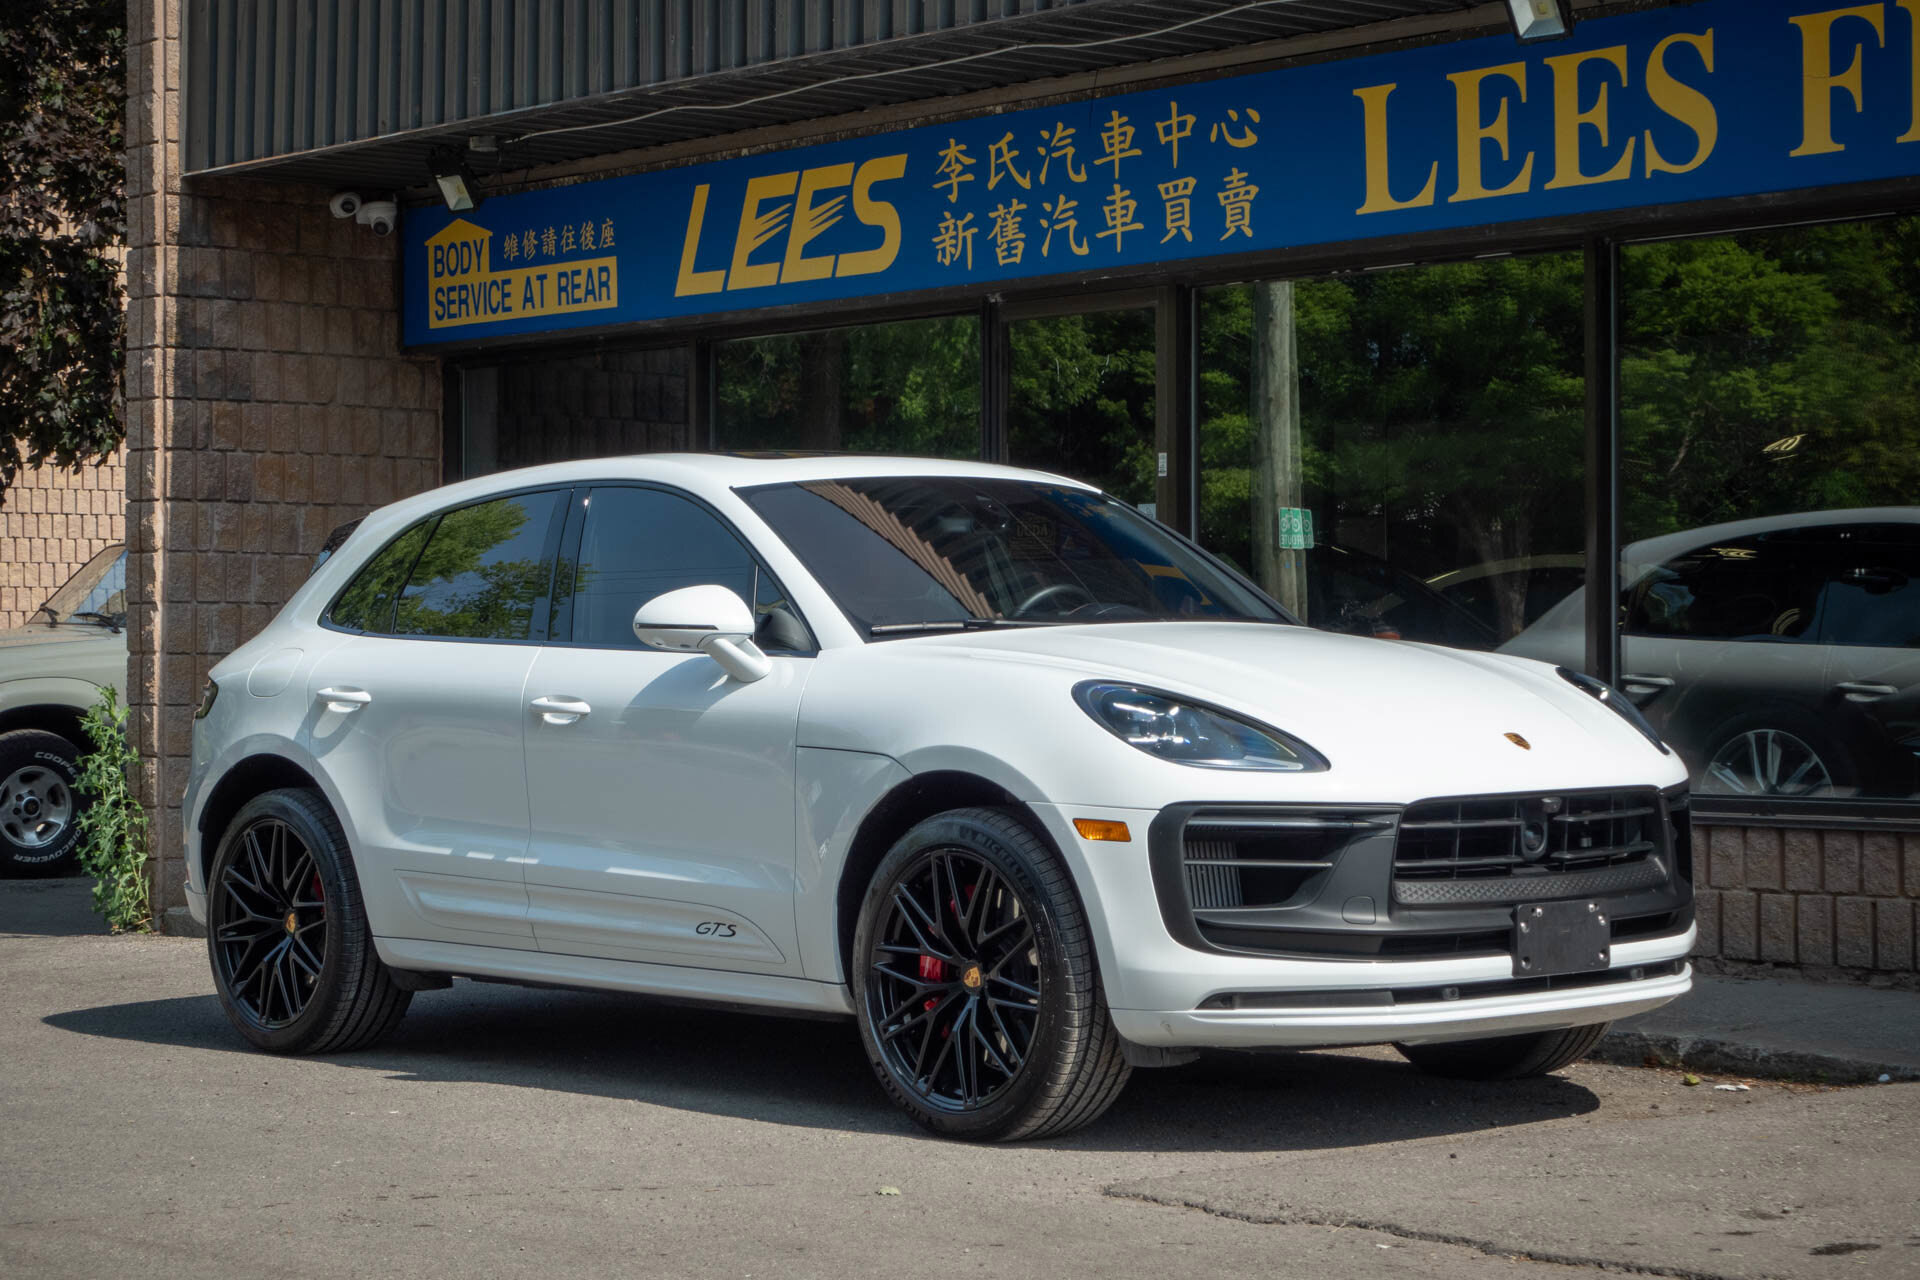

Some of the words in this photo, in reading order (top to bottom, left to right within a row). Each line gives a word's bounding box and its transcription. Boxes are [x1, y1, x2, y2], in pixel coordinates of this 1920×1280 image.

[931, 100, 1261, 204] 李氏汽車中心
[1352, 27, 1719, 216] LEES
[433, 237, 485, 278] BODY
[673, 152, 909, 298] LEES
[931, 167, 1260, 271] 新舊汽車買賣
[434, 278, 513, 321] SERVICE
[522, 273, 548, 311] AT
[557, 265, 611, 307] REAR
[696, 921, 737, 938] GTS
